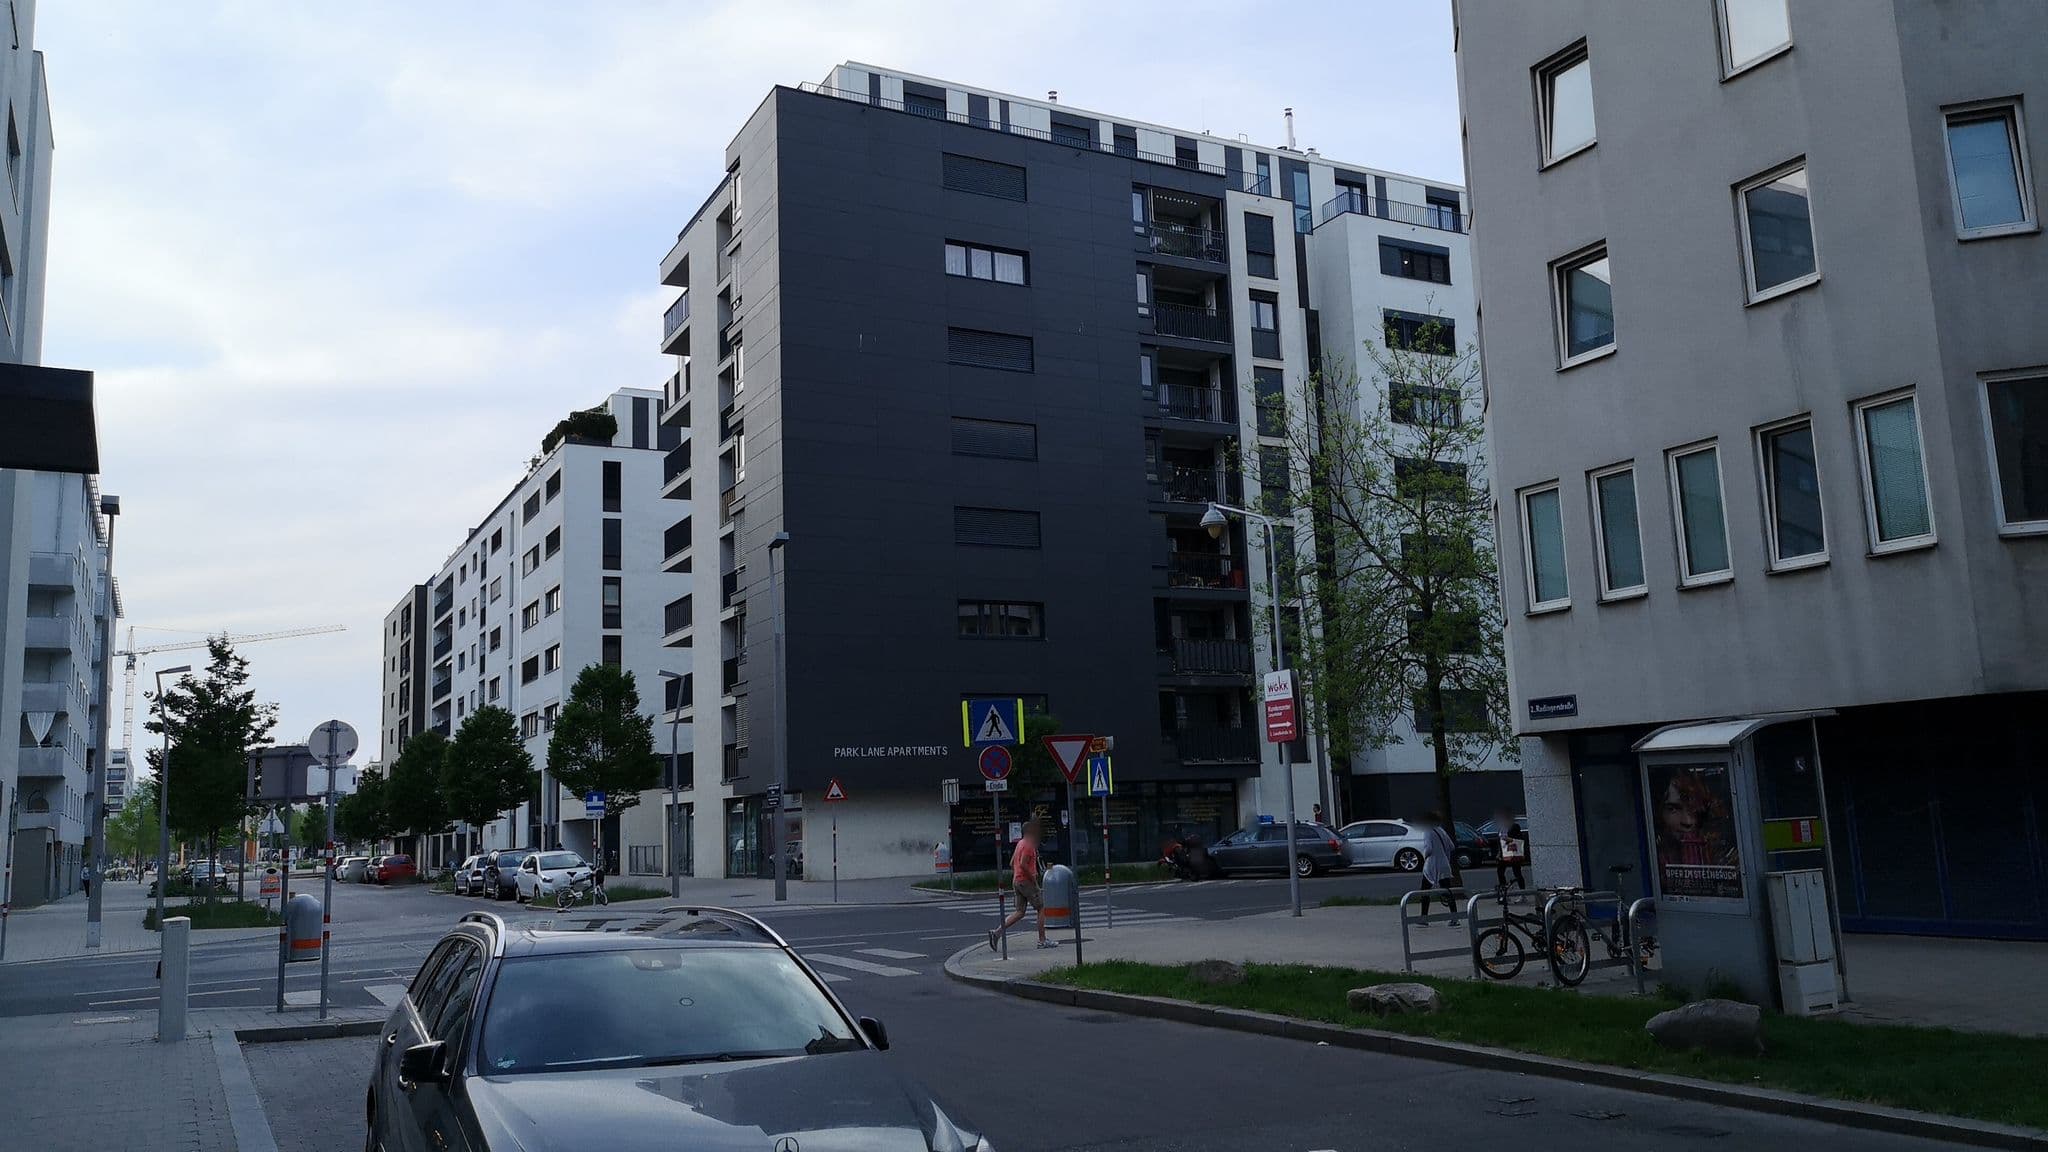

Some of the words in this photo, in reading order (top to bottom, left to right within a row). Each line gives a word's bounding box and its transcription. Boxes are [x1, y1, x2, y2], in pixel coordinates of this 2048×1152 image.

[834, 747, 860, 758] PARK
[861, 747, 886, 757] LANE
[887, 745, 949, 757] APARTMENTS
